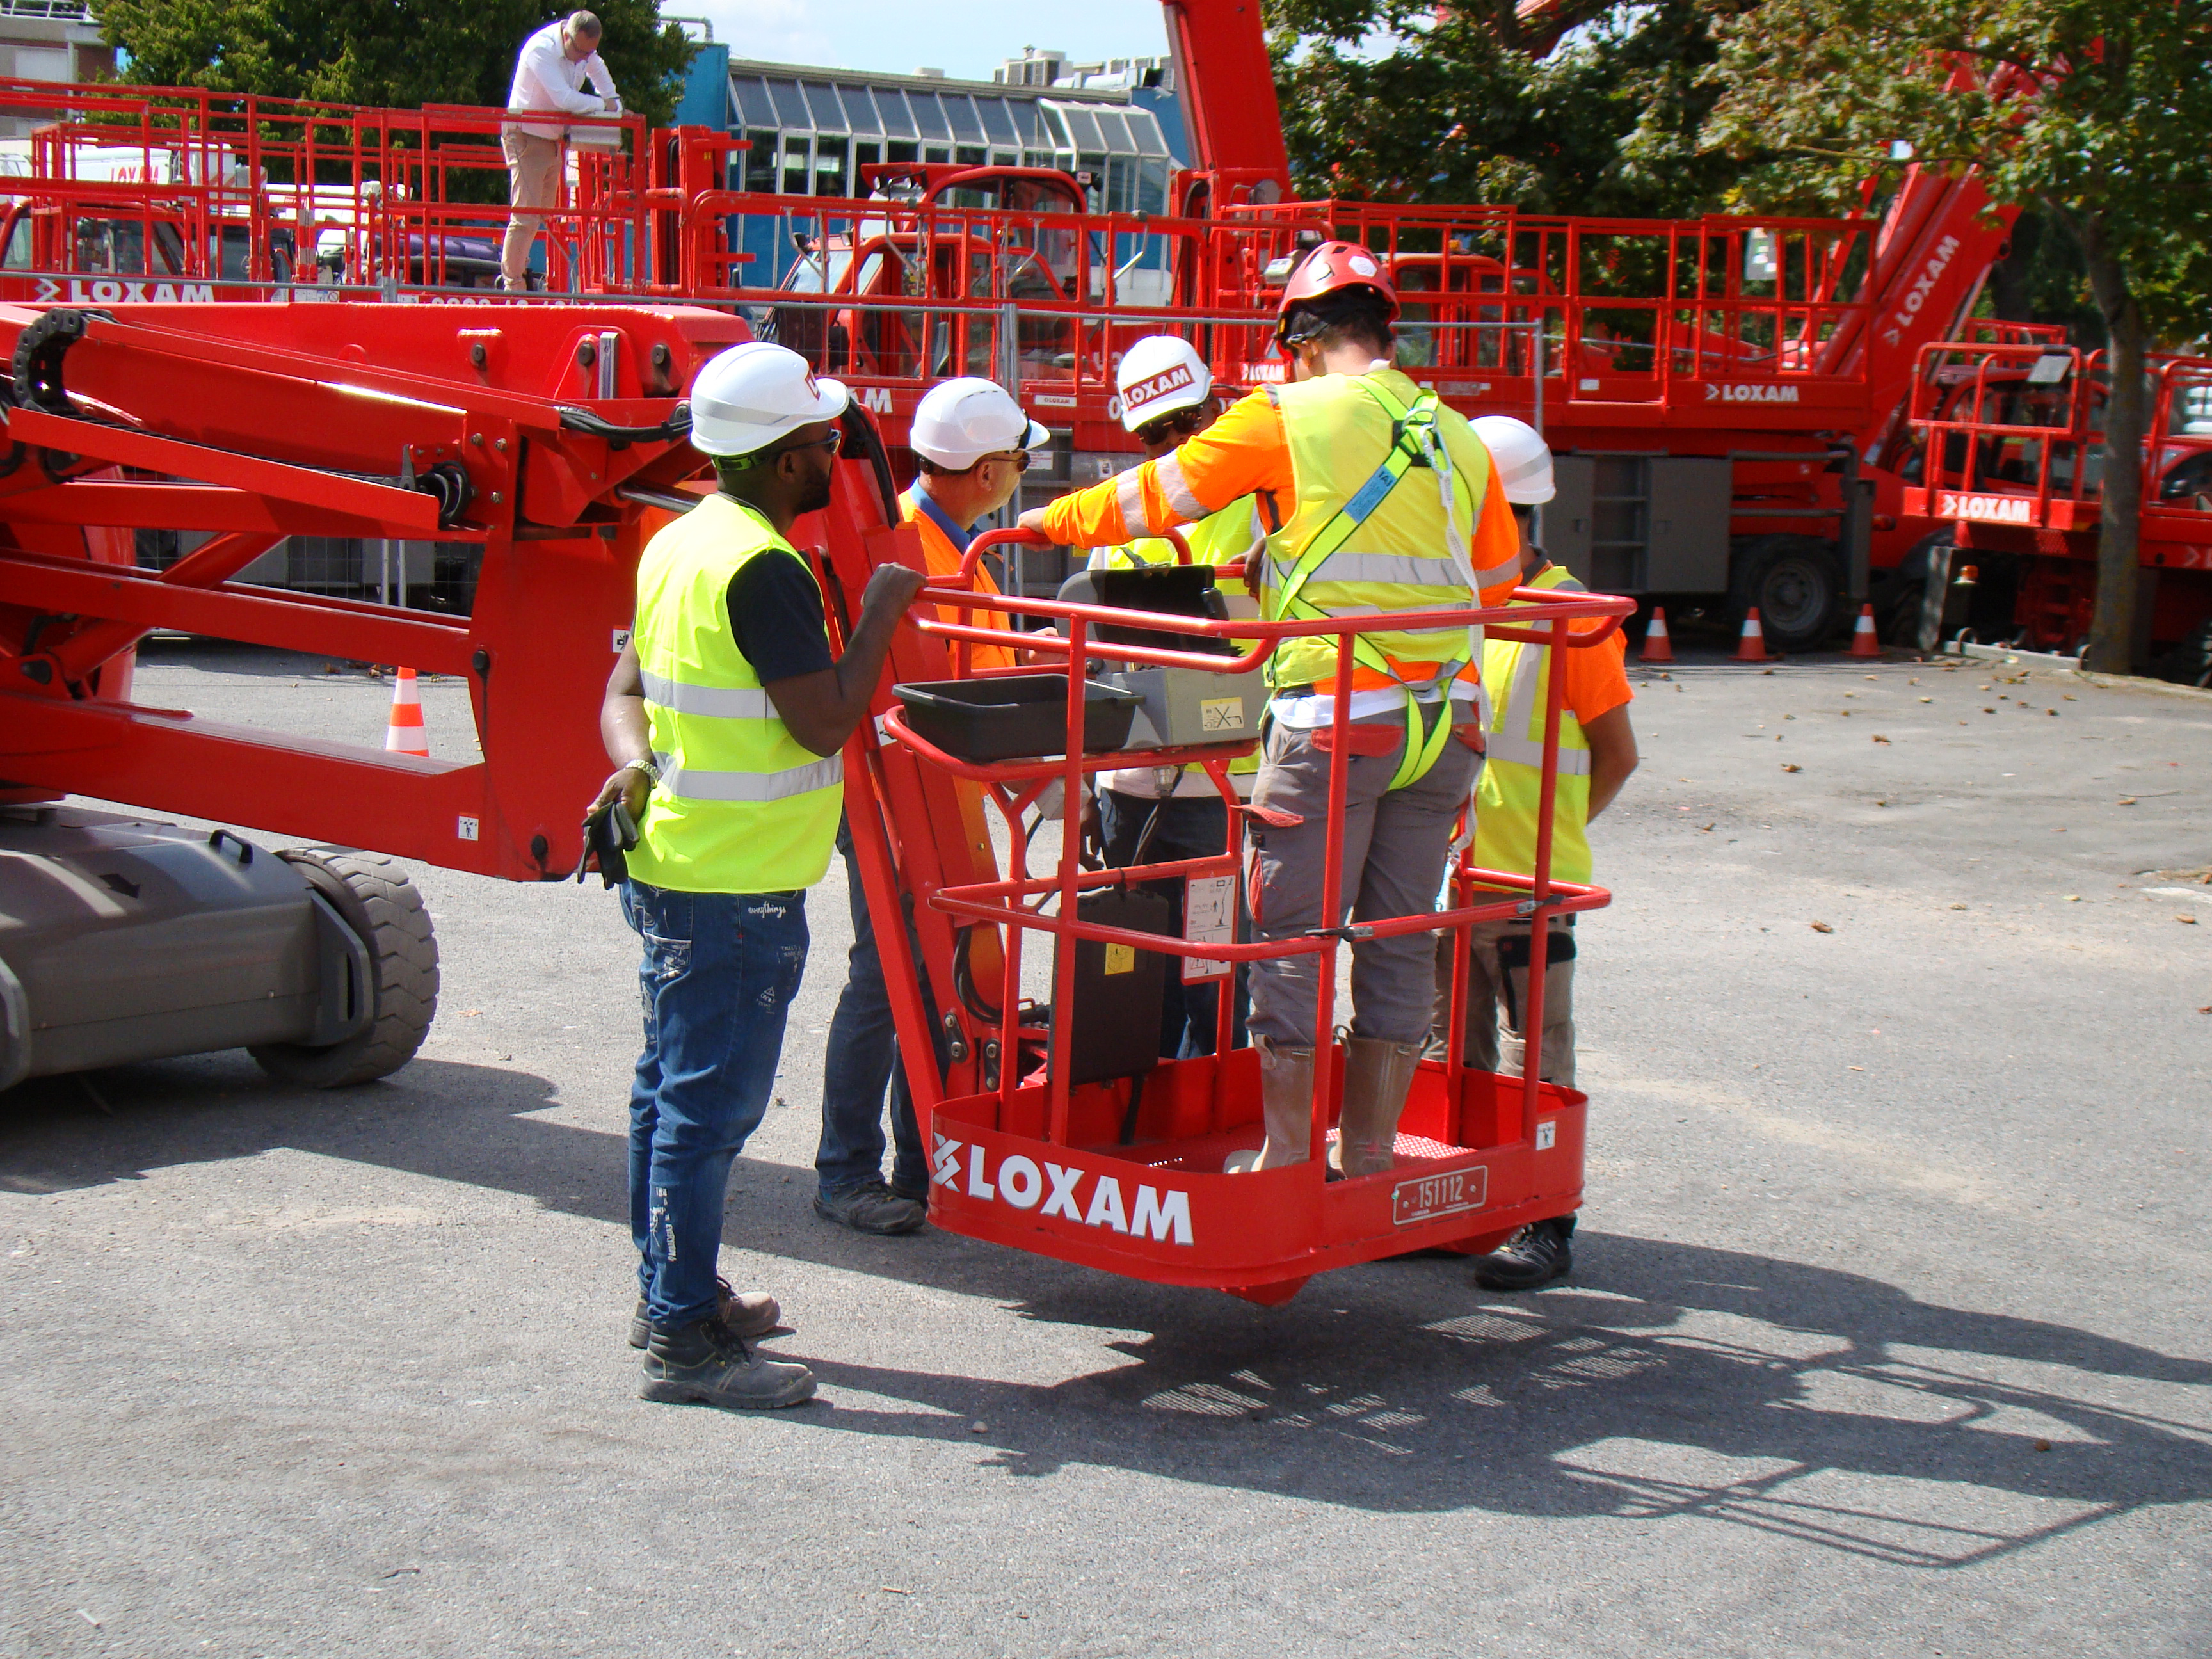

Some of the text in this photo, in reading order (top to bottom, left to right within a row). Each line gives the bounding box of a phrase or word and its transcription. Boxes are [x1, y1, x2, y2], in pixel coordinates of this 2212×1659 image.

[70, 279, 215, 303] LOXAM
[1896, 235, 1960, 327] LOXAM
[1124, 367, 1191, 408] LOXAM
[1722, 384, 1799, 402] LOXAM
[1957, 495, 2030, 523] LOXAM
[968, 1144, 1195, 1246] LOXAM
[1419, 1174, 1464, 1209] 151112
